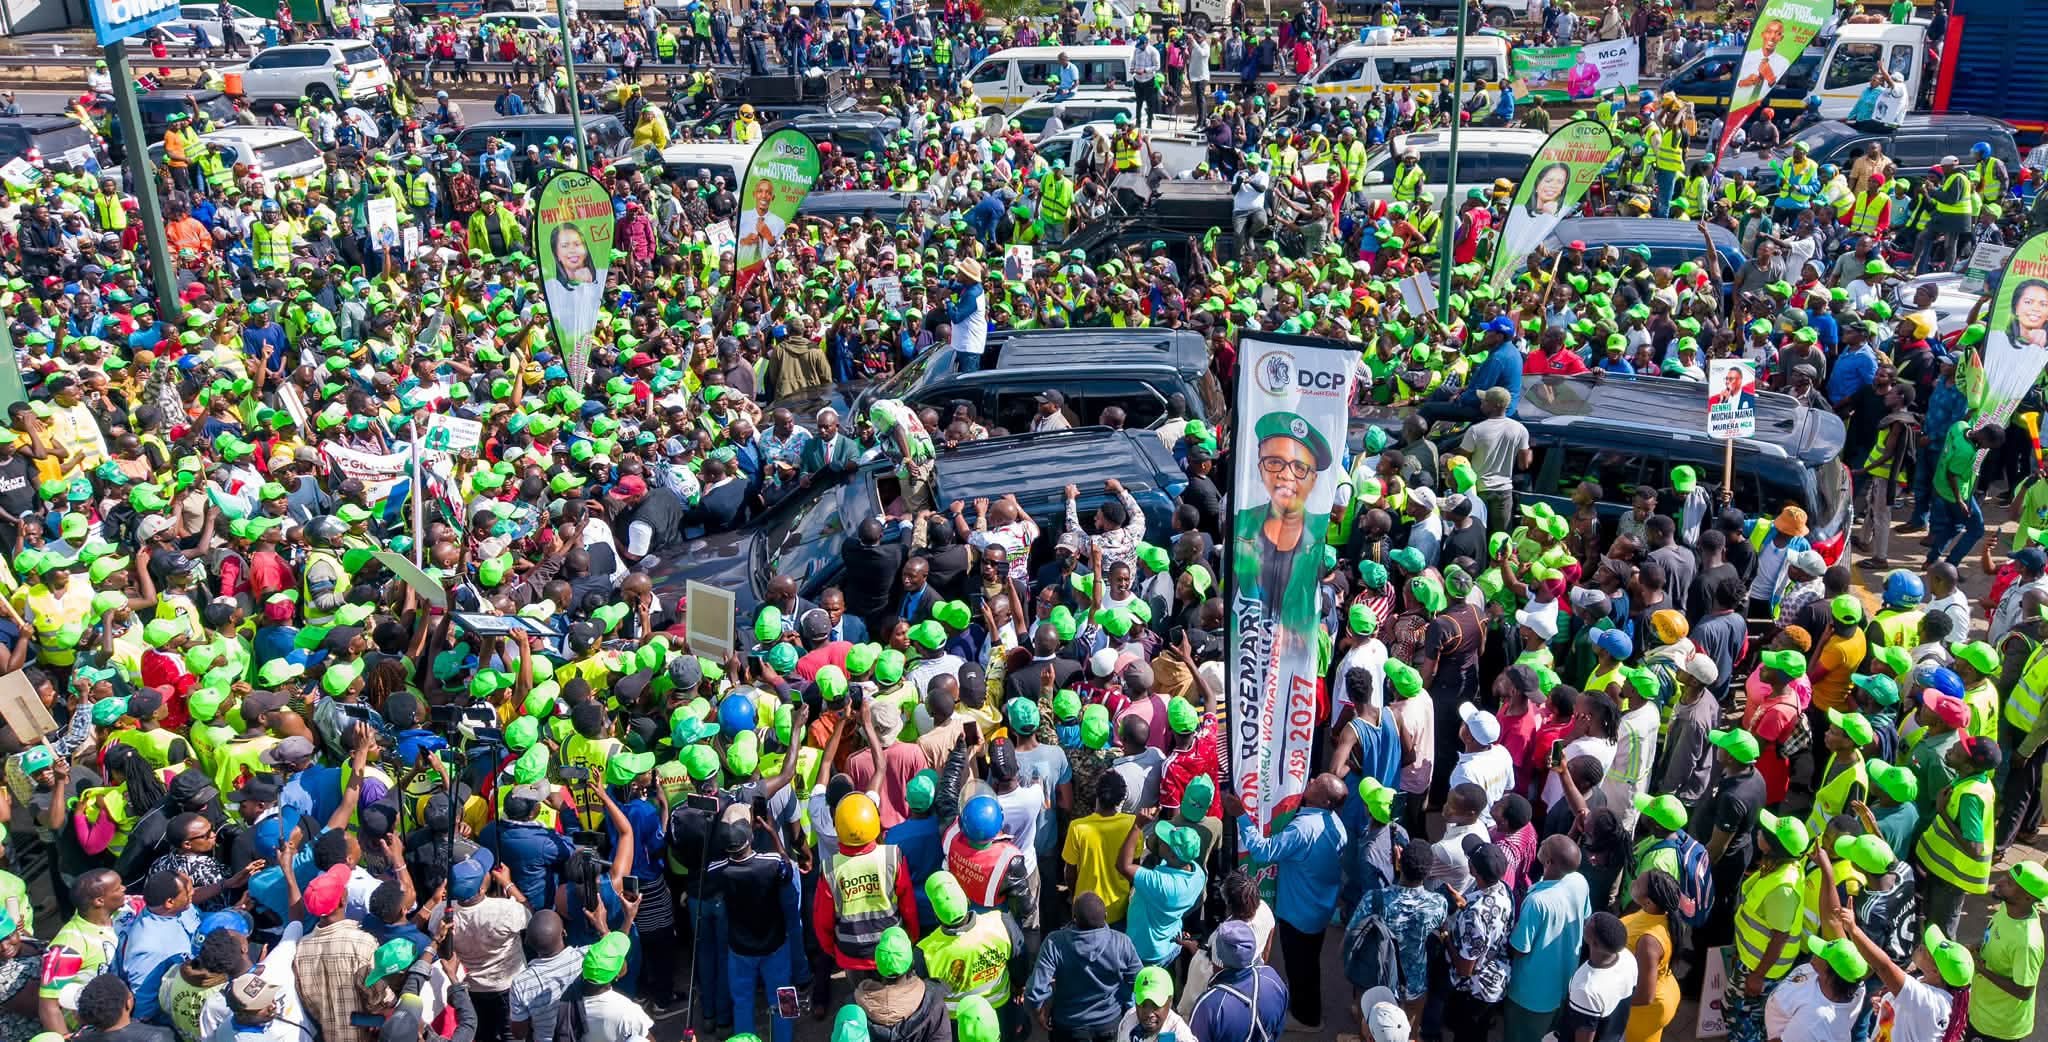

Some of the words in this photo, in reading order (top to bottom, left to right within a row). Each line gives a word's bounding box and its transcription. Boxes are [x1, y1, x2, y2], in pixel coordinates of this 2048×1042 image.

[1599, 48, 1627, 60] MCA
[1583, 126, 1605, 136] DCP
[785, 144, 806, 155] DCP
[570, 177, 592, 188] DCP
[1298, 369, 1346, 390] DCP
[1711, 411, 1734, 421] MUCHAI
[1734, 408, 1753, 418] MAINA
[1712, 422, 1739, 431] MURERA
[1238, 597, 1261, 761] ROSEMARY
[1262, 672, 1278, 742] WOMAN
[1290, 674, 1313, 742] 2027
[954, 851, 983, 873] TUNNEL
[844, 882, 880, 899] yangu
